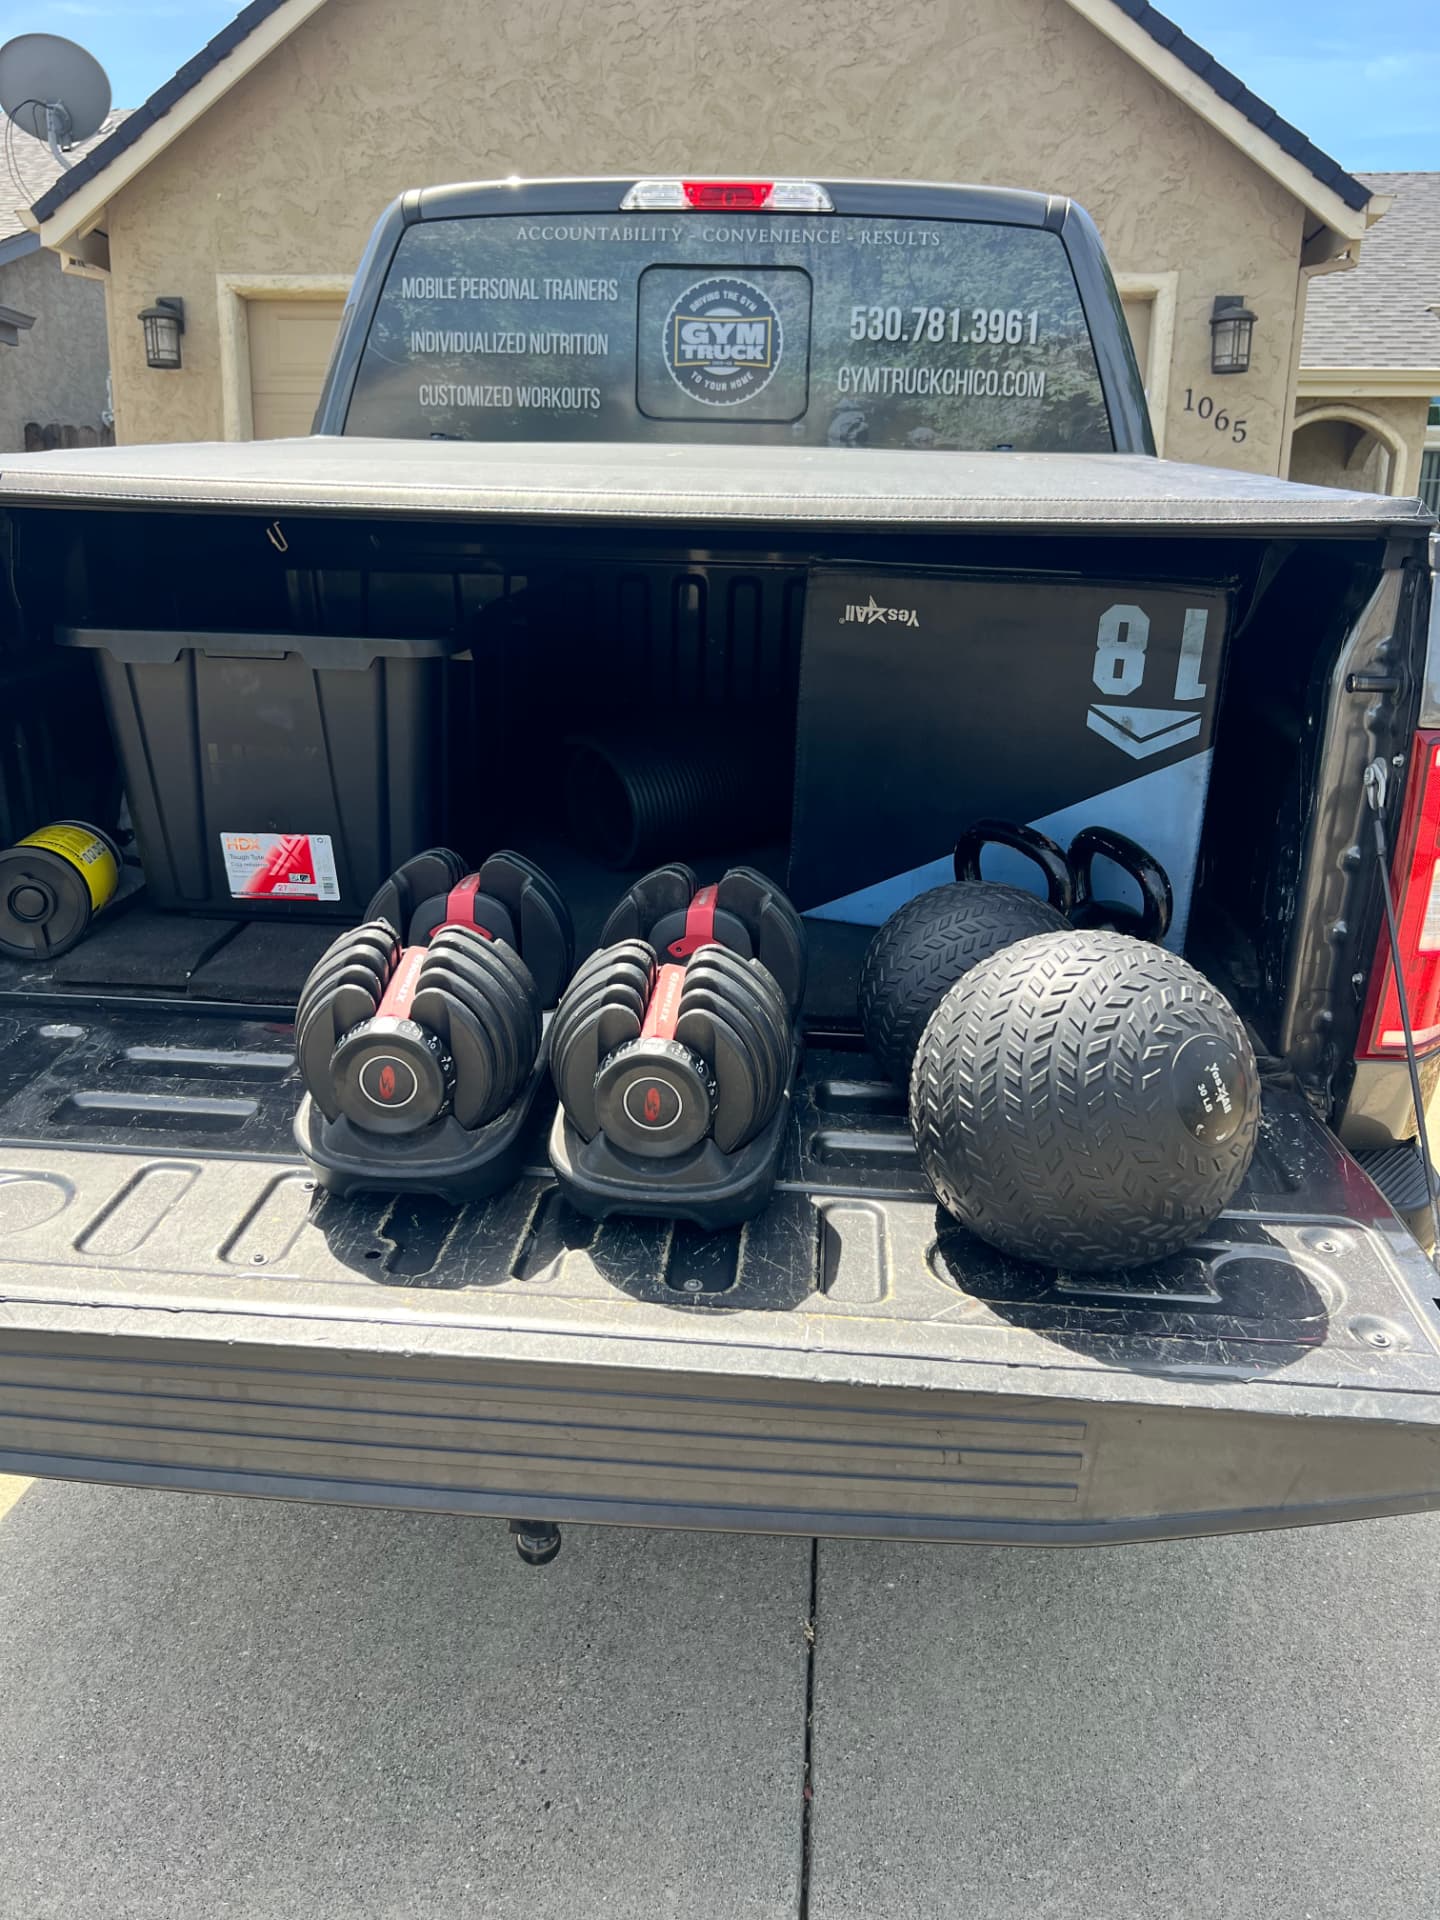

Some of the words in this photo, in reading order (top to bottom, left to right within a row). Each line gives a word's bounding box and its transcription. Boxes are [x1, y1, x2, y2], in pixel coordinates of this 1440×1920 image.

[516, 226, 682, 241] ACCOUNTABILITY
[702, 228, 841, 244] CONVENIENCE
[860, 231, 940, 246] RESULTS
[402, 276, 457, 299] MOBILE
[460, 277, 539, 300] PERSONAL
[543, 278, 618, 301] TRAINERS
[680, 322, 766, 345] GYM
[850, 305, 1039, 345] 530.781.3961
[411, 331, 526, 354] INDIVIDUALIZED
[529, 333, 609, 356] NUTRITION
[680, 344, 765, 361] TRUCK
[690, 370, 703, 384] TO
[704, 379, 727, 392] YOUR
[730, 371, 755, 388] HOME
[838, 366, 1046, 398] GYMTRUCKCHICO.COM
[419, 384, 513, 408] CUSTOMIZED
[516, 386, 601, 409] WORKOUTS
[1183, 388, 1247, 443] 1065
[225, 837, 262, 851] HDX
[1198, 1083, 1208, 1097] 30
[1202, 1097, 1213, 1113] LB
